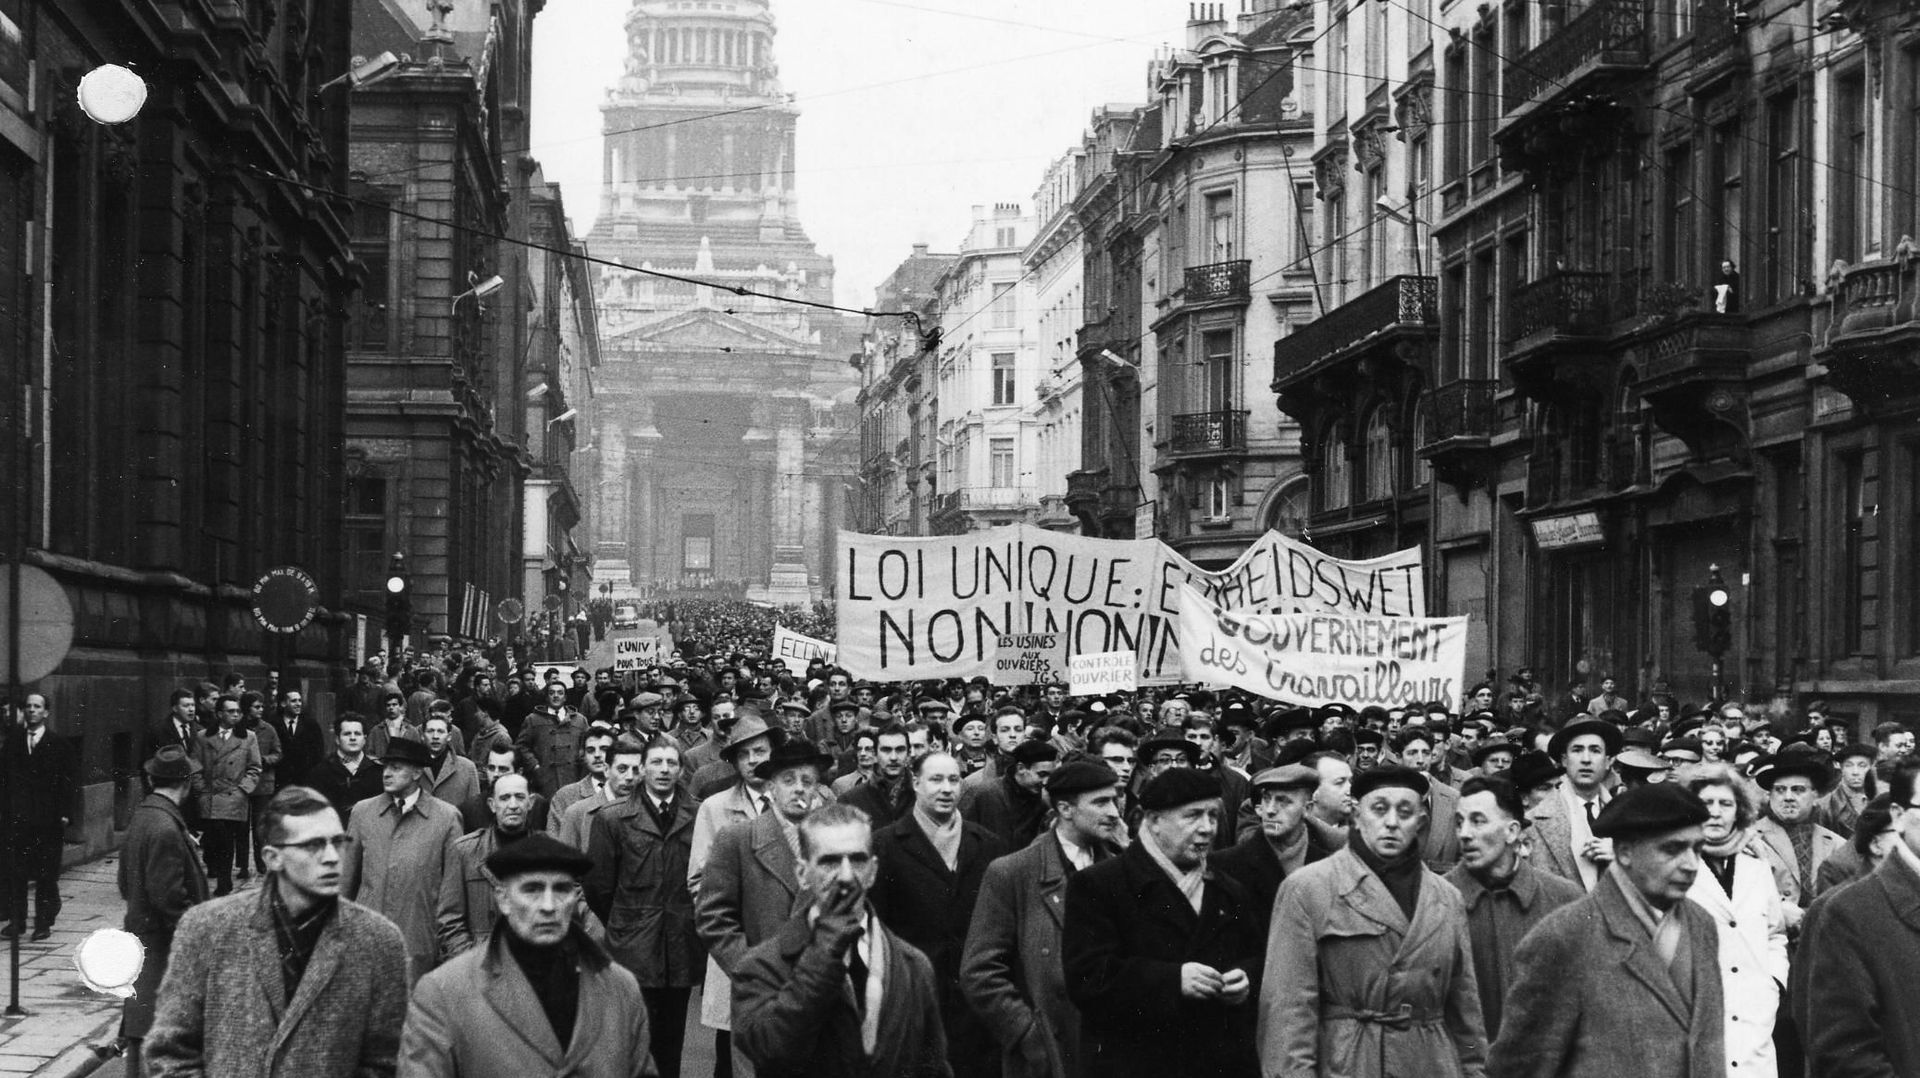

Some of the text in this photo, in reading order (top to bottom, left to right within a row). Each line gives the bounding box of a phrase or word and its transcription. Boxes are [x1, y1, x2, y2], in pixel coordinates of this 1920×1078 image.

[849, 547, 923, 601] LOI
[997, 635, 1057, 649] LES USINES
[1213, 607, 1448, 663] GOUVERNEMENT
[1021, 651, 1041, 660] AUX
[1199, 631, 1247, 675] des
[616, 659, 634, 669] POUR
[996, 659, 1051, 672] OUVRIERS
[1072, 670, 1132, 685] OUVRIER
